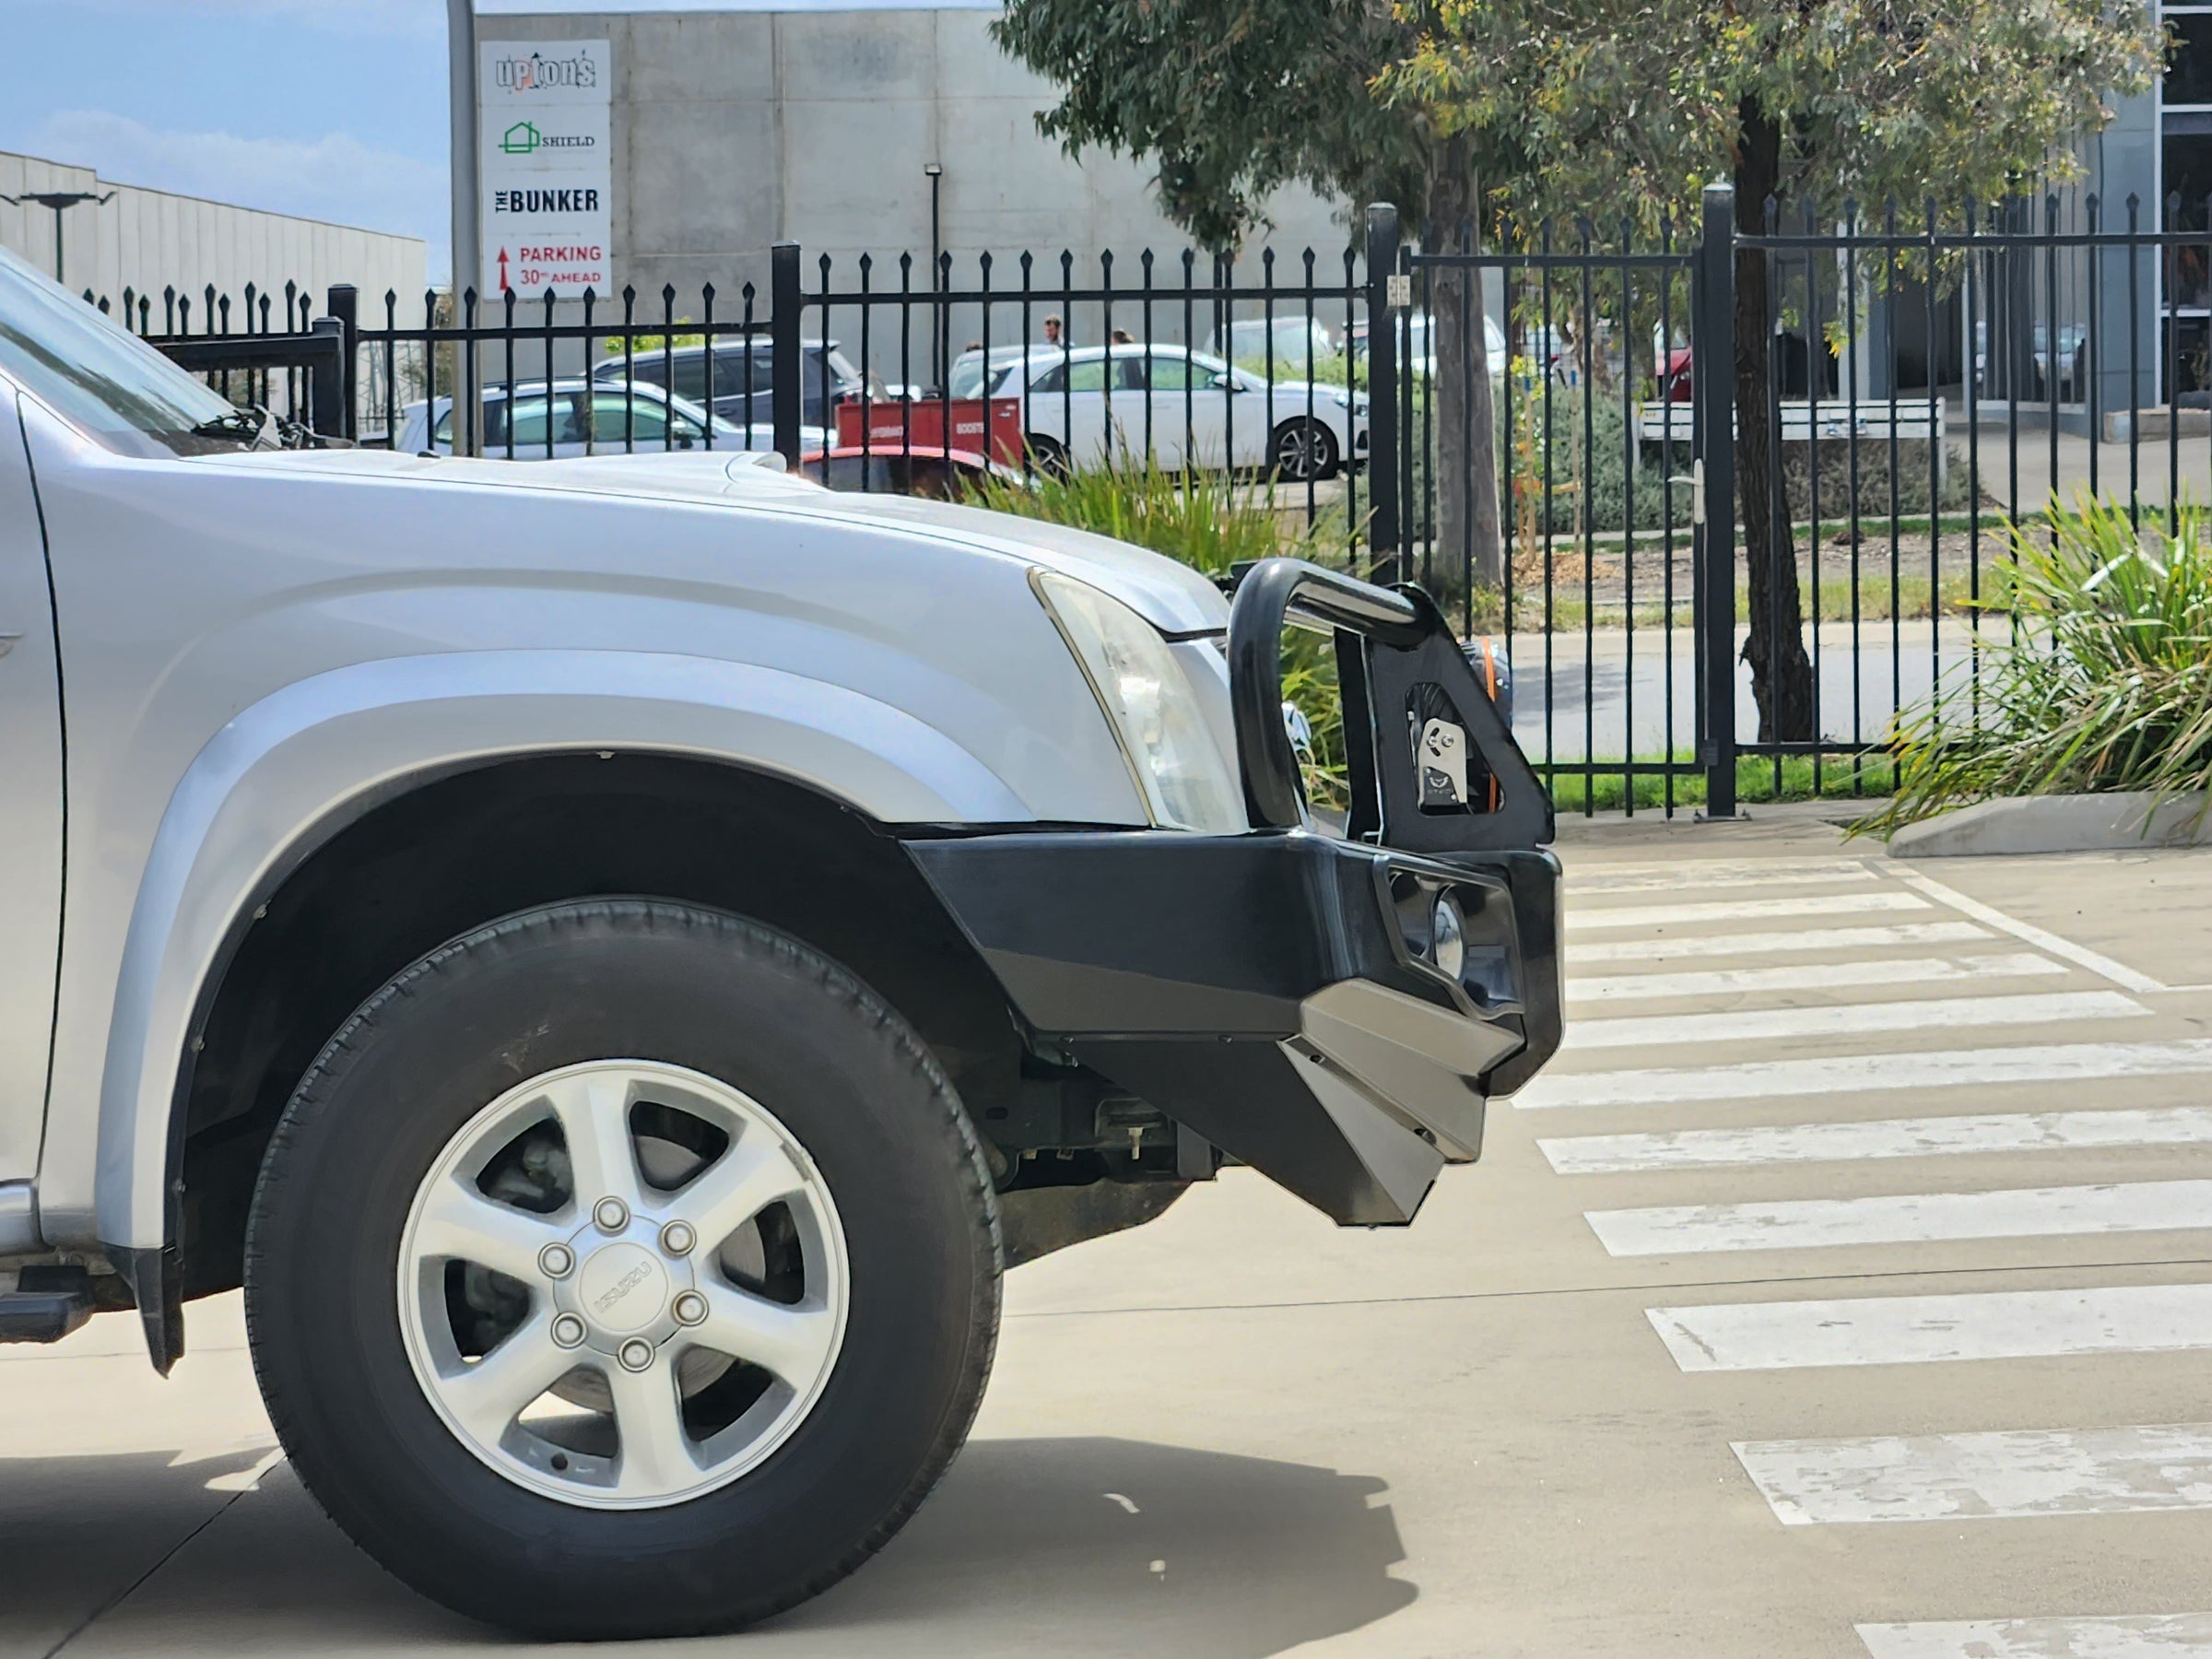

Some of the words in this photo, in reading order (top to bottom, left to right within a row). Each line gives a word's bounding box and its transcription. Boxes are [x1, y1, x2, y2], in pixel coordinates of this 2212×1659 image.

[542, 136, 595, 147] SHIELD
[495, 191, 508, 214] THE
[511, 189, 599, 213] BUNKER
[520, 246, 602, 263] PARKING
[551, 273, 602, 283] AHEAD
[594, 1261, 653, 1313] ISUZU
